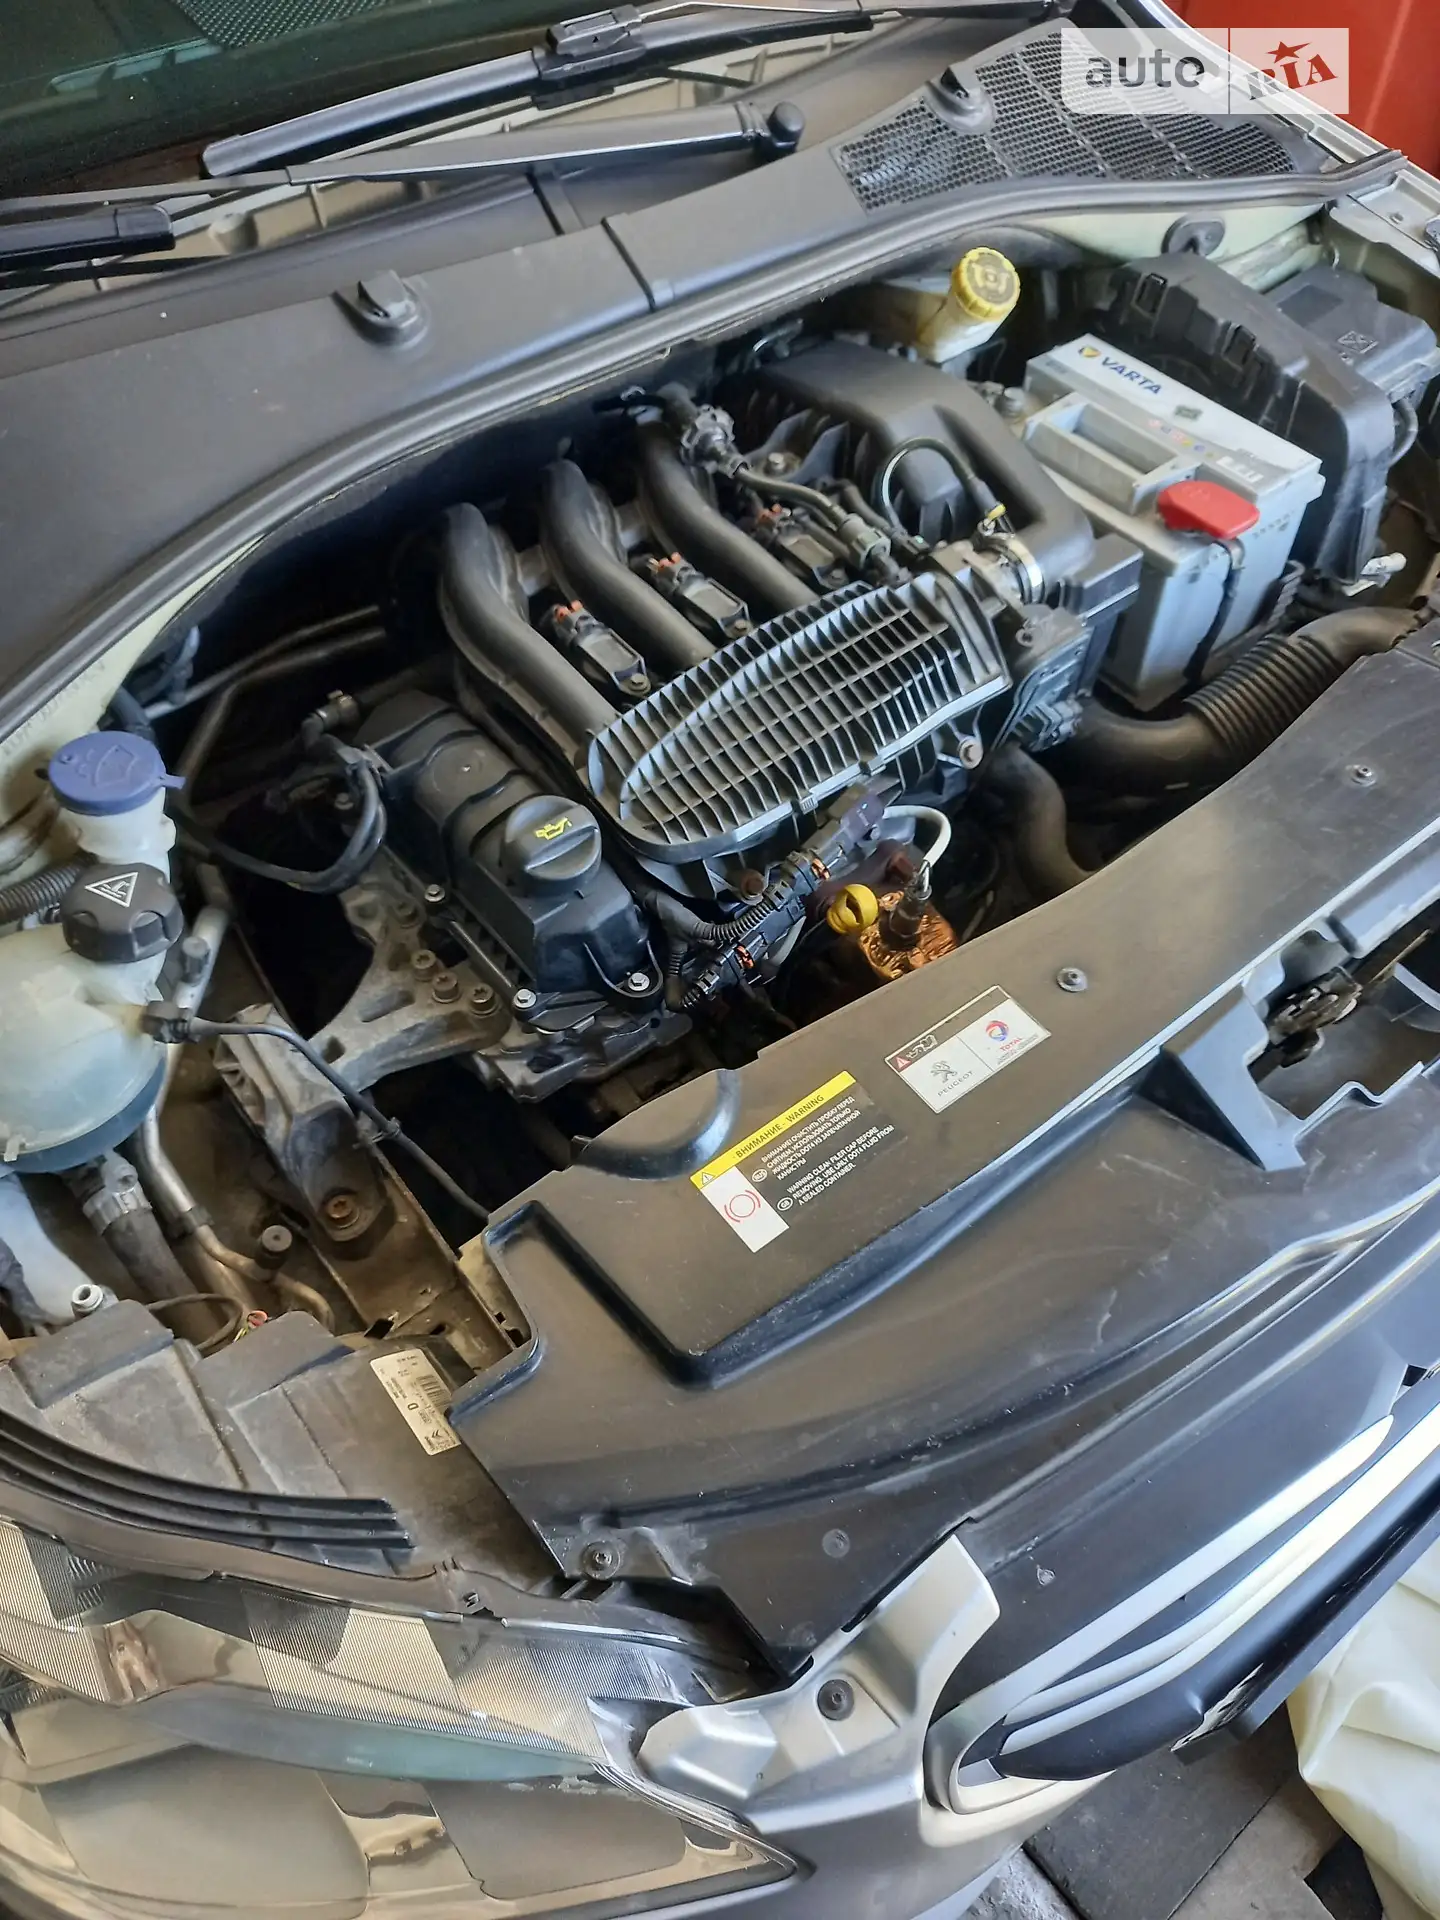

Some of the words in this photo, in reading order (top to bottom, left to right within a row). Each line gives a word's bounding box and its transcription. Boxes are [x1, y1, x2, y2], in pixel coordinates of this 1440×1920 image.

[1102, 357, 1161, 394] VARTA
[1000, 1036, 1024, 1052] TOTAL
[938, 1070, 973, 1097] PEUGEOT
[735, 1122, 783, 1158] ВНИМАНИЕ
[785, 1093, 825, 1123] WARNING
[787, 1173, 813, 1193] WARNING
[812, 1161, 831, 1175] CLEAN
[830, 1149, 846, 1163] FILER
[845, 1141, 857, 1152] CAP
[856, 1127, 878, 1144] BEFORE
[800, 1142, 814, 1154] DOT4
[822, 1167, 835, 1178] USE
[833, 1157, 849, 1170] ONLY
[847, 1147, 863, 1159] DOT4
[862, 1136, 878, 1149] FLUID
[876, 1125, 894, 1138] FROM
[802, 1184, 824, 1201] SEALED
